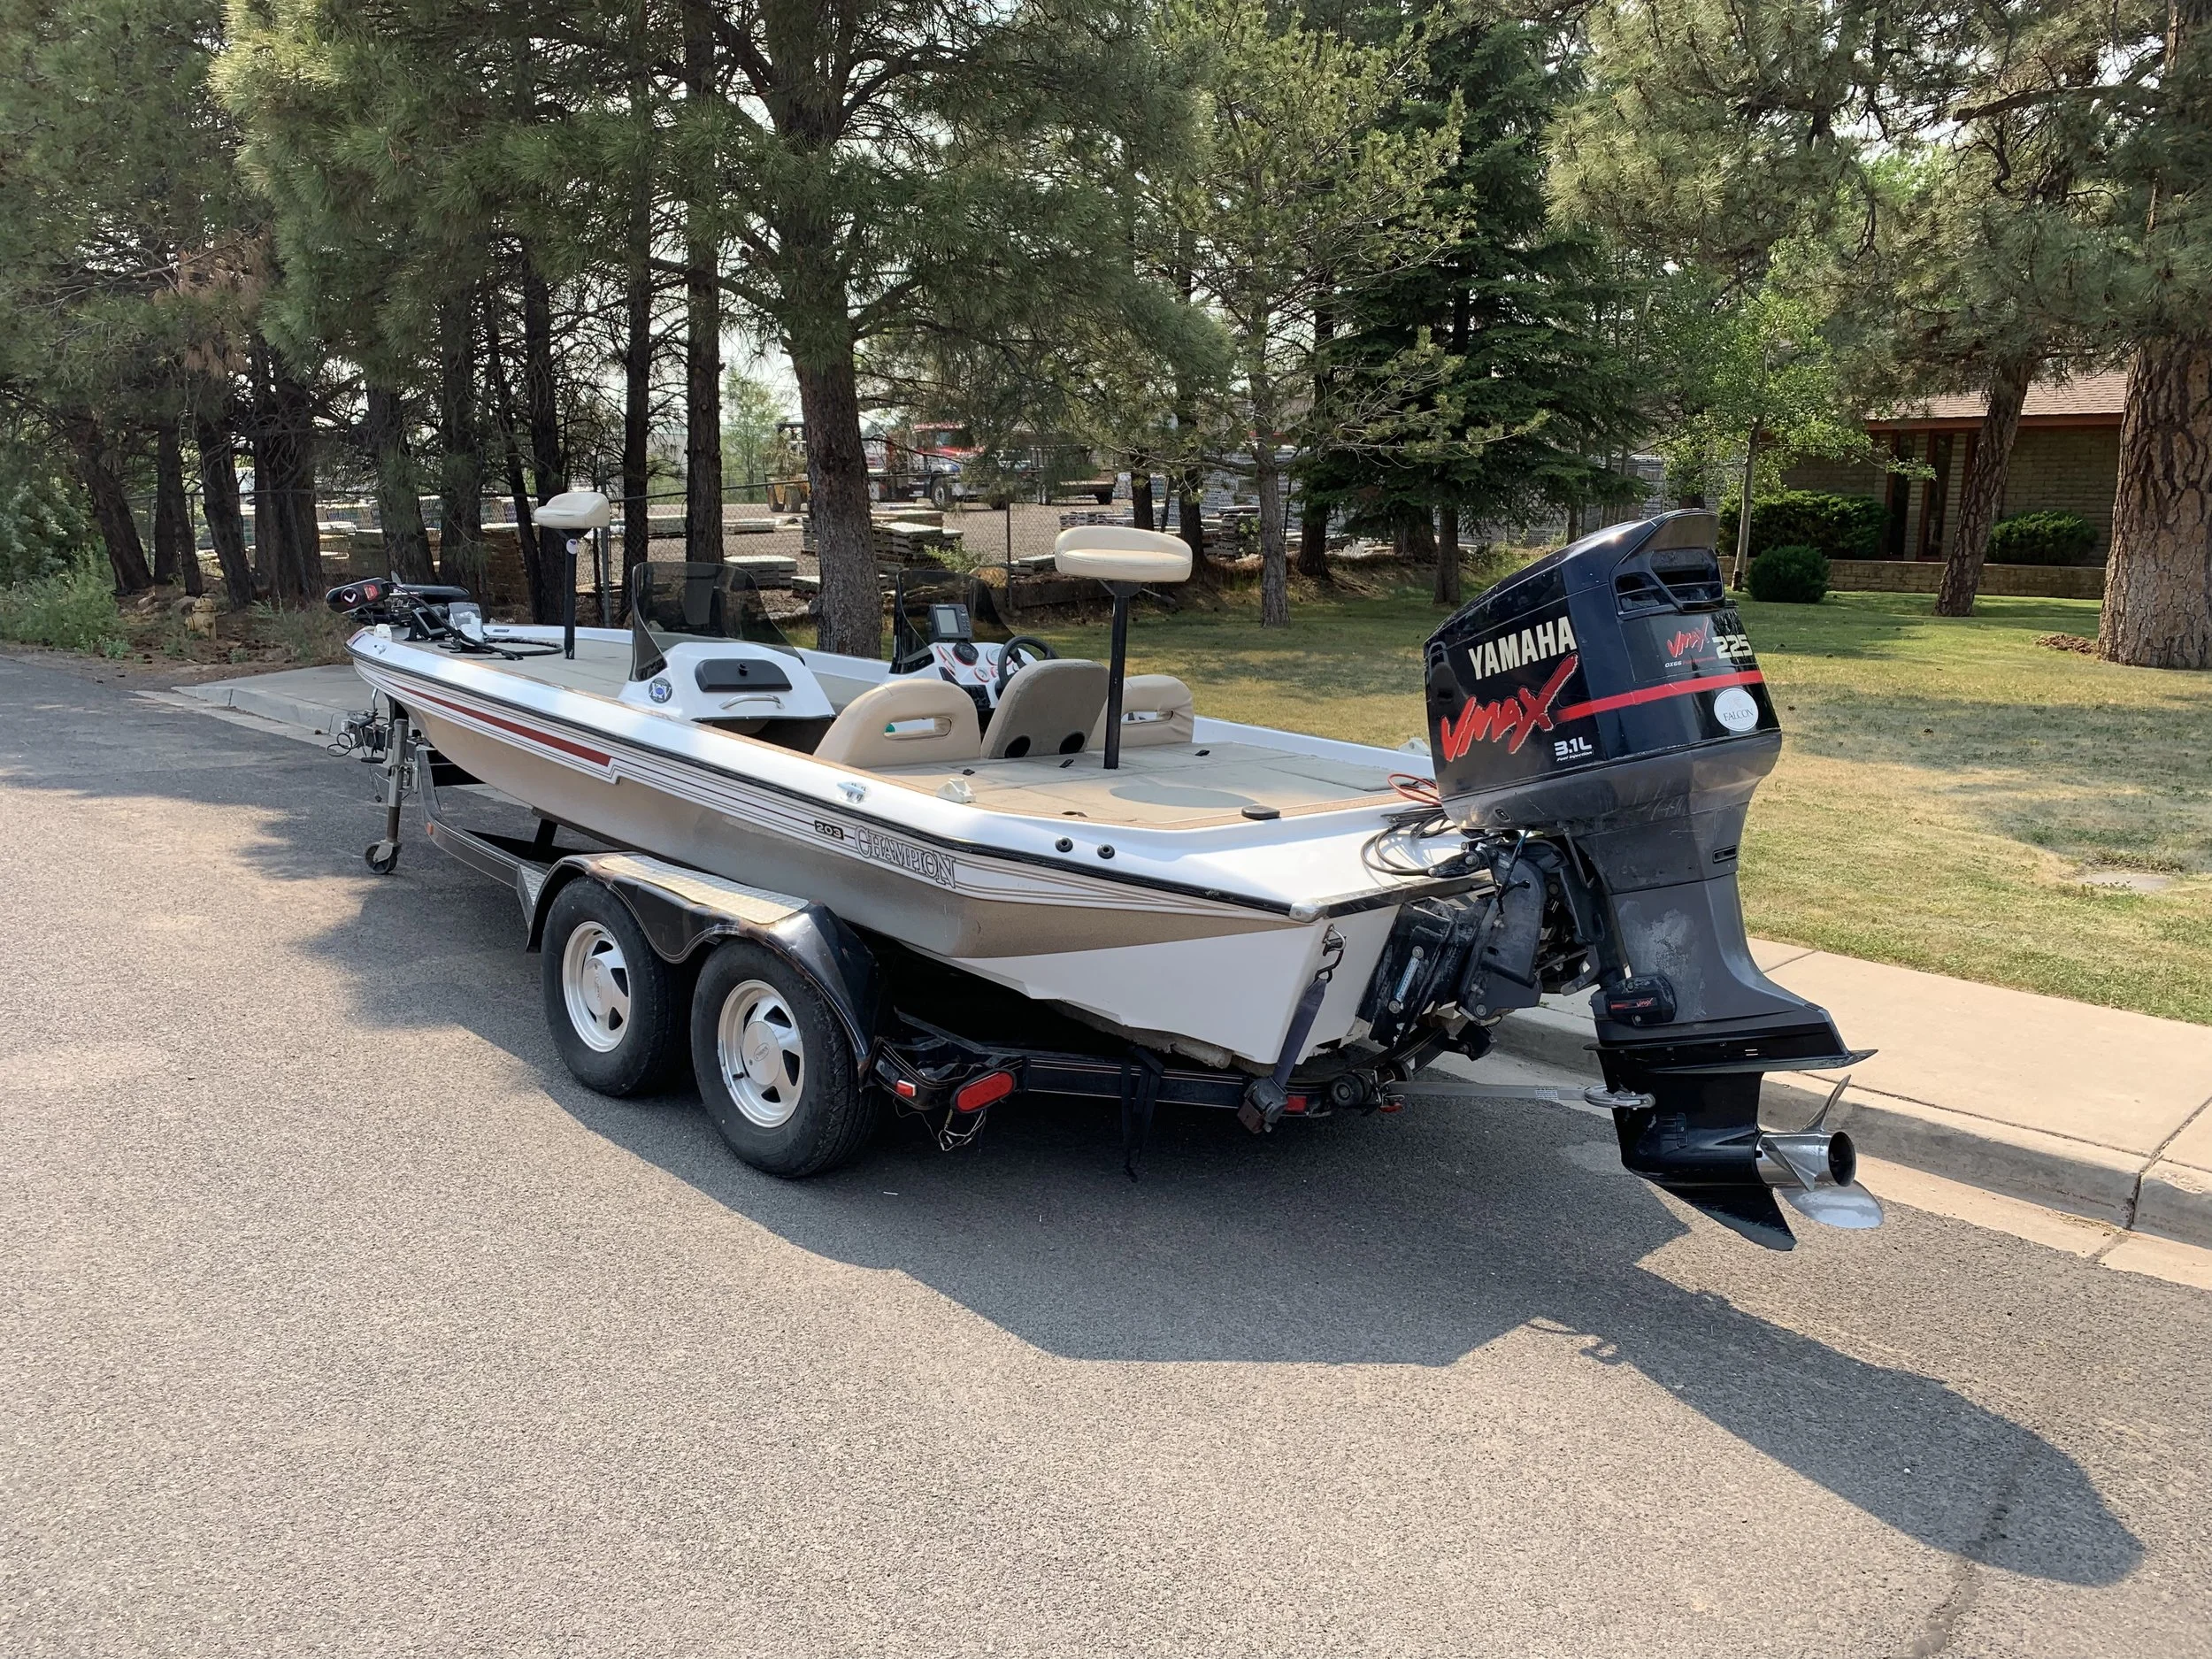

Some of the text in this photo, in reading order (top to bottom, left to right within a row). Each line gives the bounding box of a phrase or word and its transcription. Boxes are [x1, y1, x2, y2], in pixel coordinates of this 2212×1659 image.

[1468, 616, 1578, 680] YAMAHA
[1712, 634, 1753, 659] 225
[1723, 709, 1754, 722] FALCON
[1554, 736, 1593, 757] 3.1L
[816, 823, 956, 889] 203 CHAMPION
